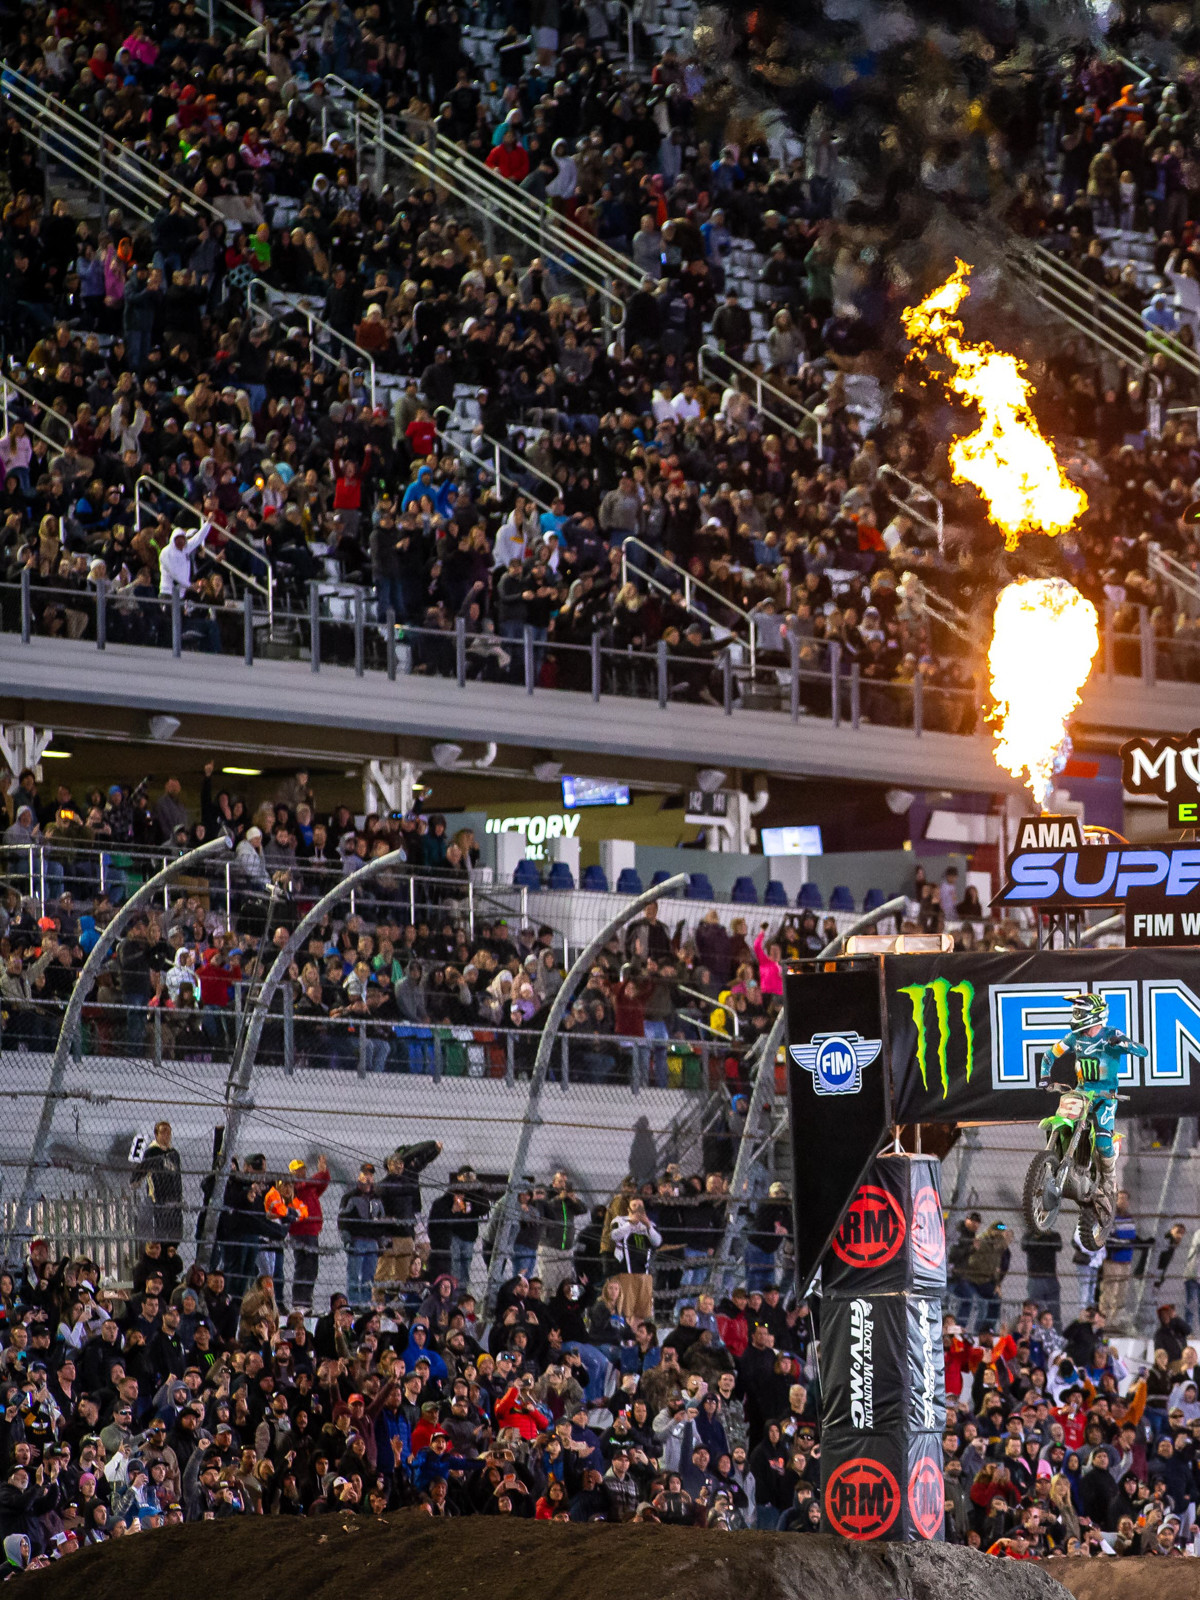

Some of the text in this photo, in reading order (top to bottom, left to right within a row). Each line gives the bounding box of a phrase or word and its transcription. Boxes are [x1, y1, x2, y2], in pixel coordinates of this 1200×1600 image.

[1021, 823, 1078, 848] AMA
[1133, 914, 1174, 938] FIM
[822, 1051, 852, 1075] FIM
[843, 1209, 889, 1244] RM
[863, 1319, 873, 1430] ROCKY MOUNTAIN
[839, 1483, 884, 1516] RM
